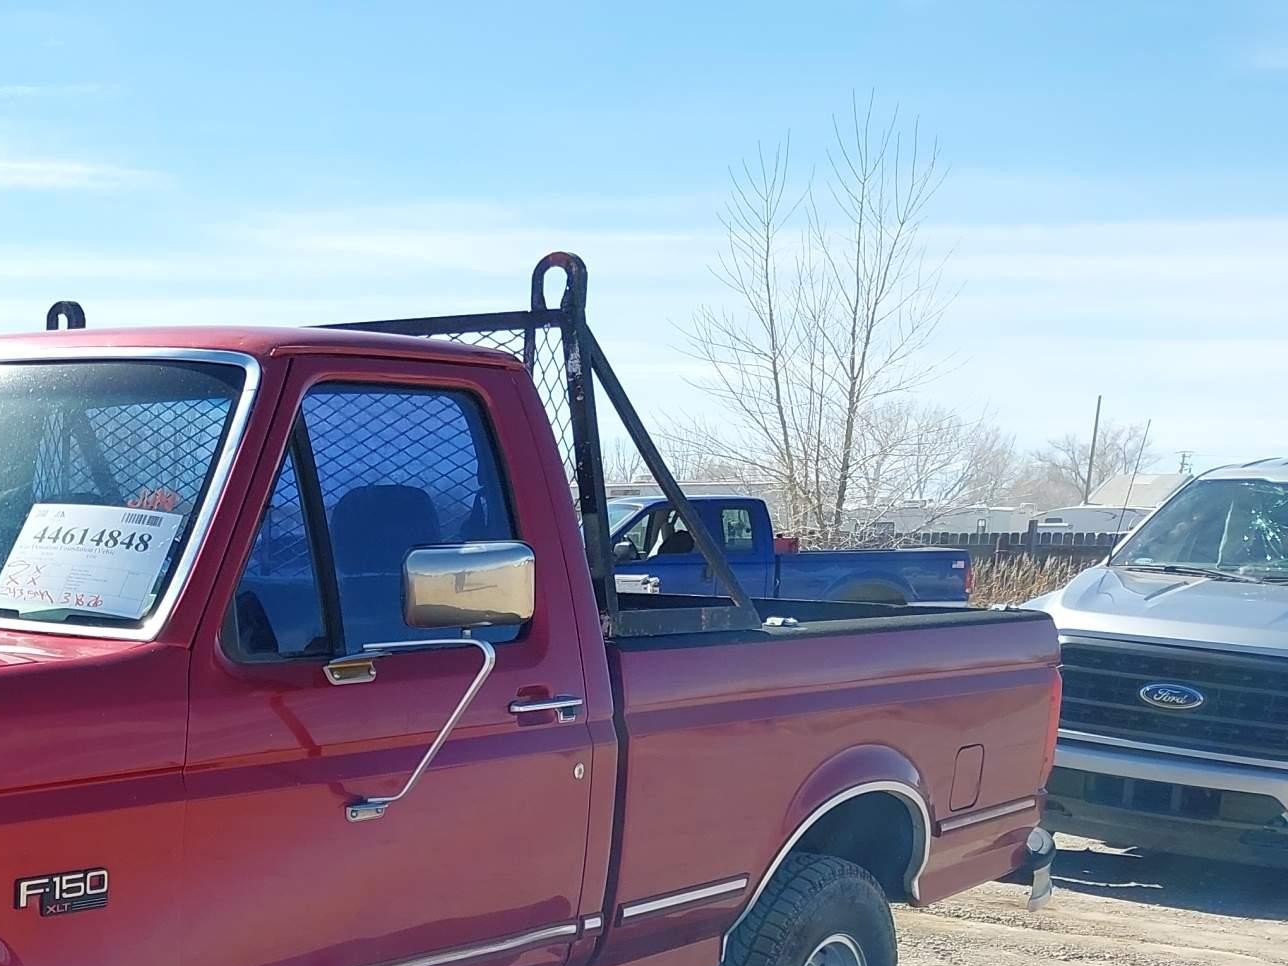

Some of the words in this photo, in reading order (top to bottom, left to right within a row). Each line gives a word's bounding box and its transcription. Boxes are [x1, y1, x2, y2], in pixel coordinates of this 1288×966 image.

[33, 525, 153, 553] 44614848
[1153, 688, 1188, 704] Ford
[45, 902, 72, 915] XLT
